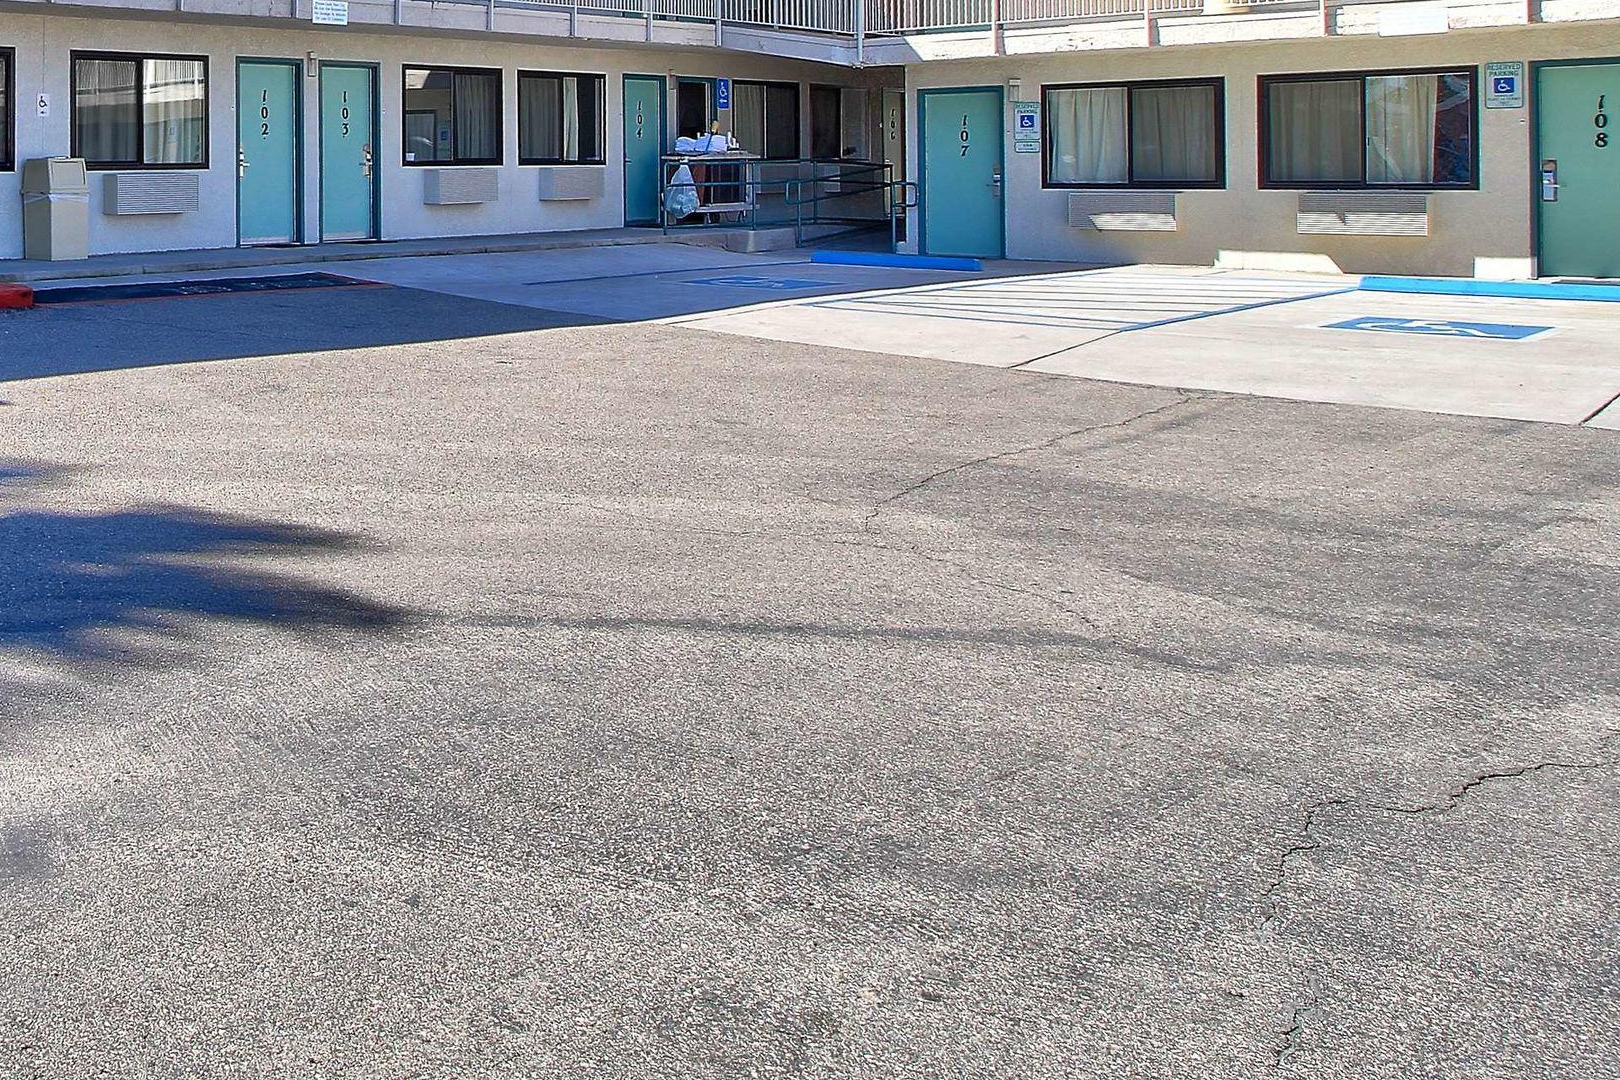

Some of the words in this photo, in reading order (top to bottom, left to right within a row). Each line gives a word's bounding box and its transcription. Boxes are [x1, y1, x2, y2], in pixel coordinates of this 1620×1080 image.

[260, 89, 269, 136] 102
[341, 90, 349, 136] 103
[960, 114, 970, 157] 107
[1594, 94, 1609, 148] 108
